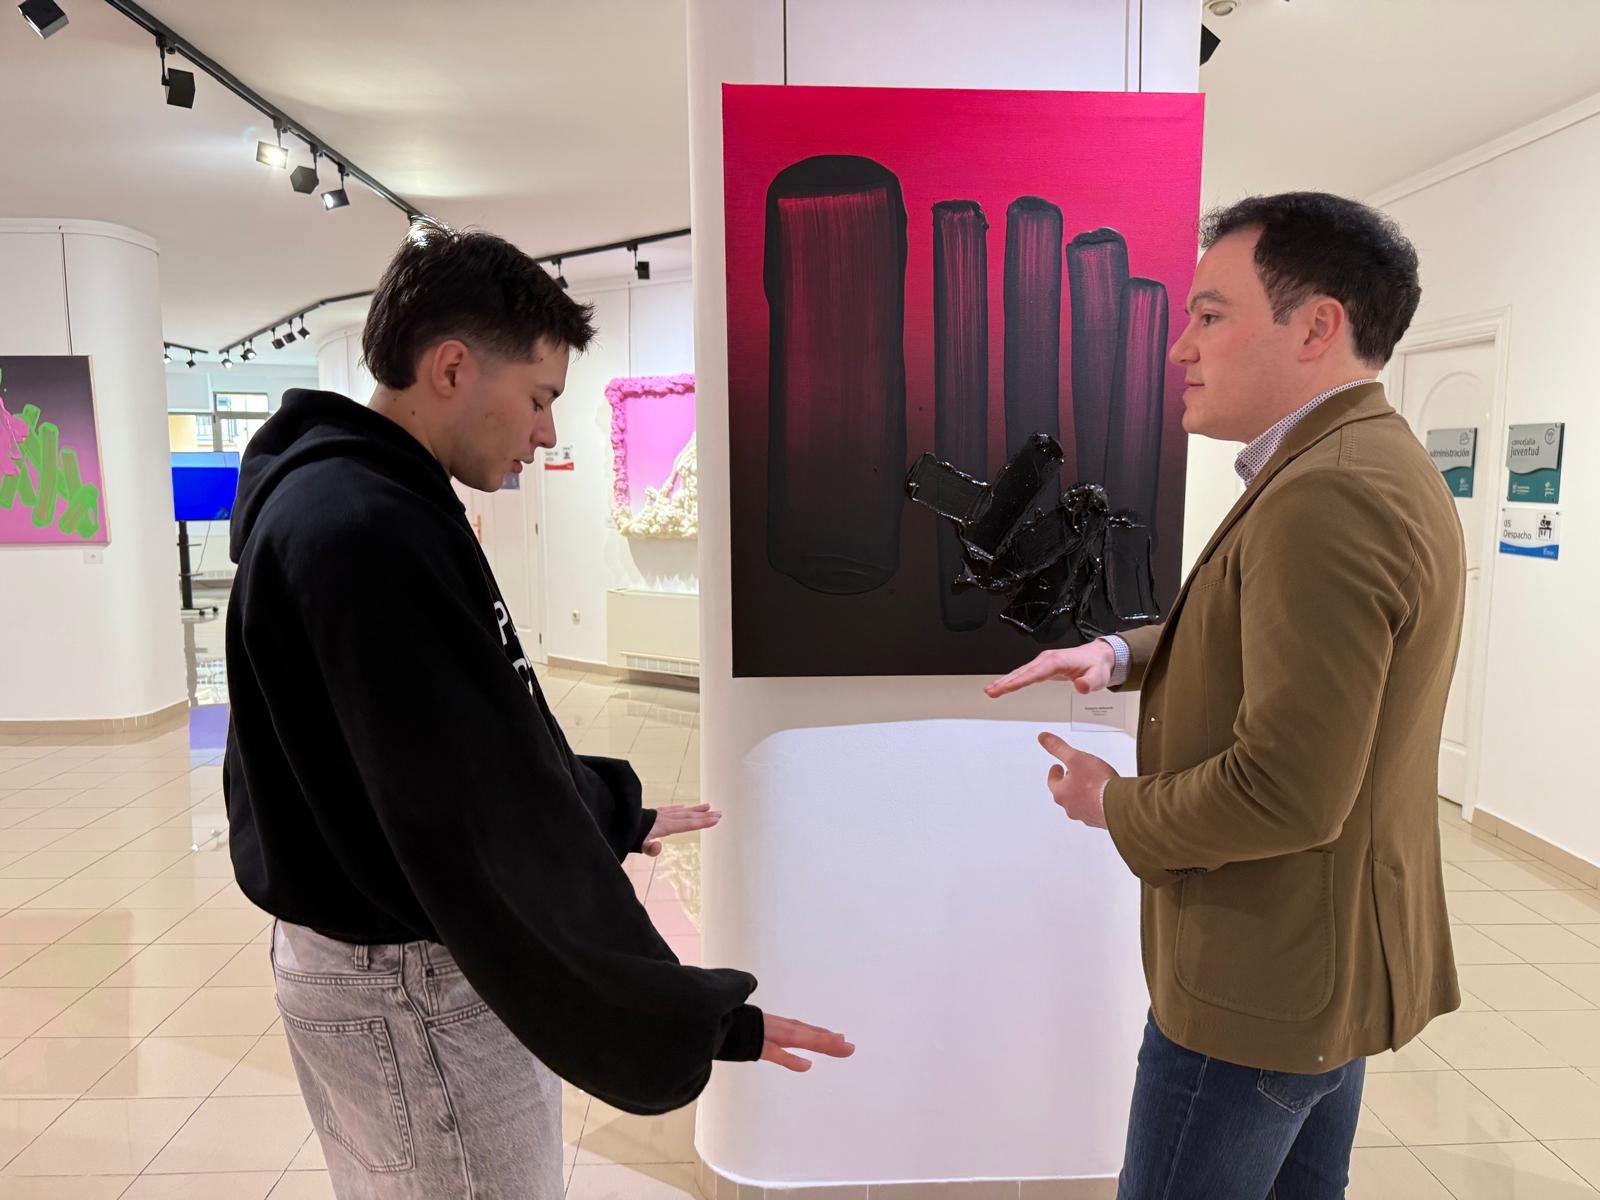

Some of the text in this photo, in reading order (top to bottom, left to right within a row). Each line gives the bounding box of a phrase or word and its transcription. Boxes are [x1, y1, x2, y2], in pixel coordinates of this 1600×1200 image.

[1430, 447, 1470, 457] dministración
[1510, 445, 1540, 458] juventud
[1503, 529, 1532, 540] Despacho
